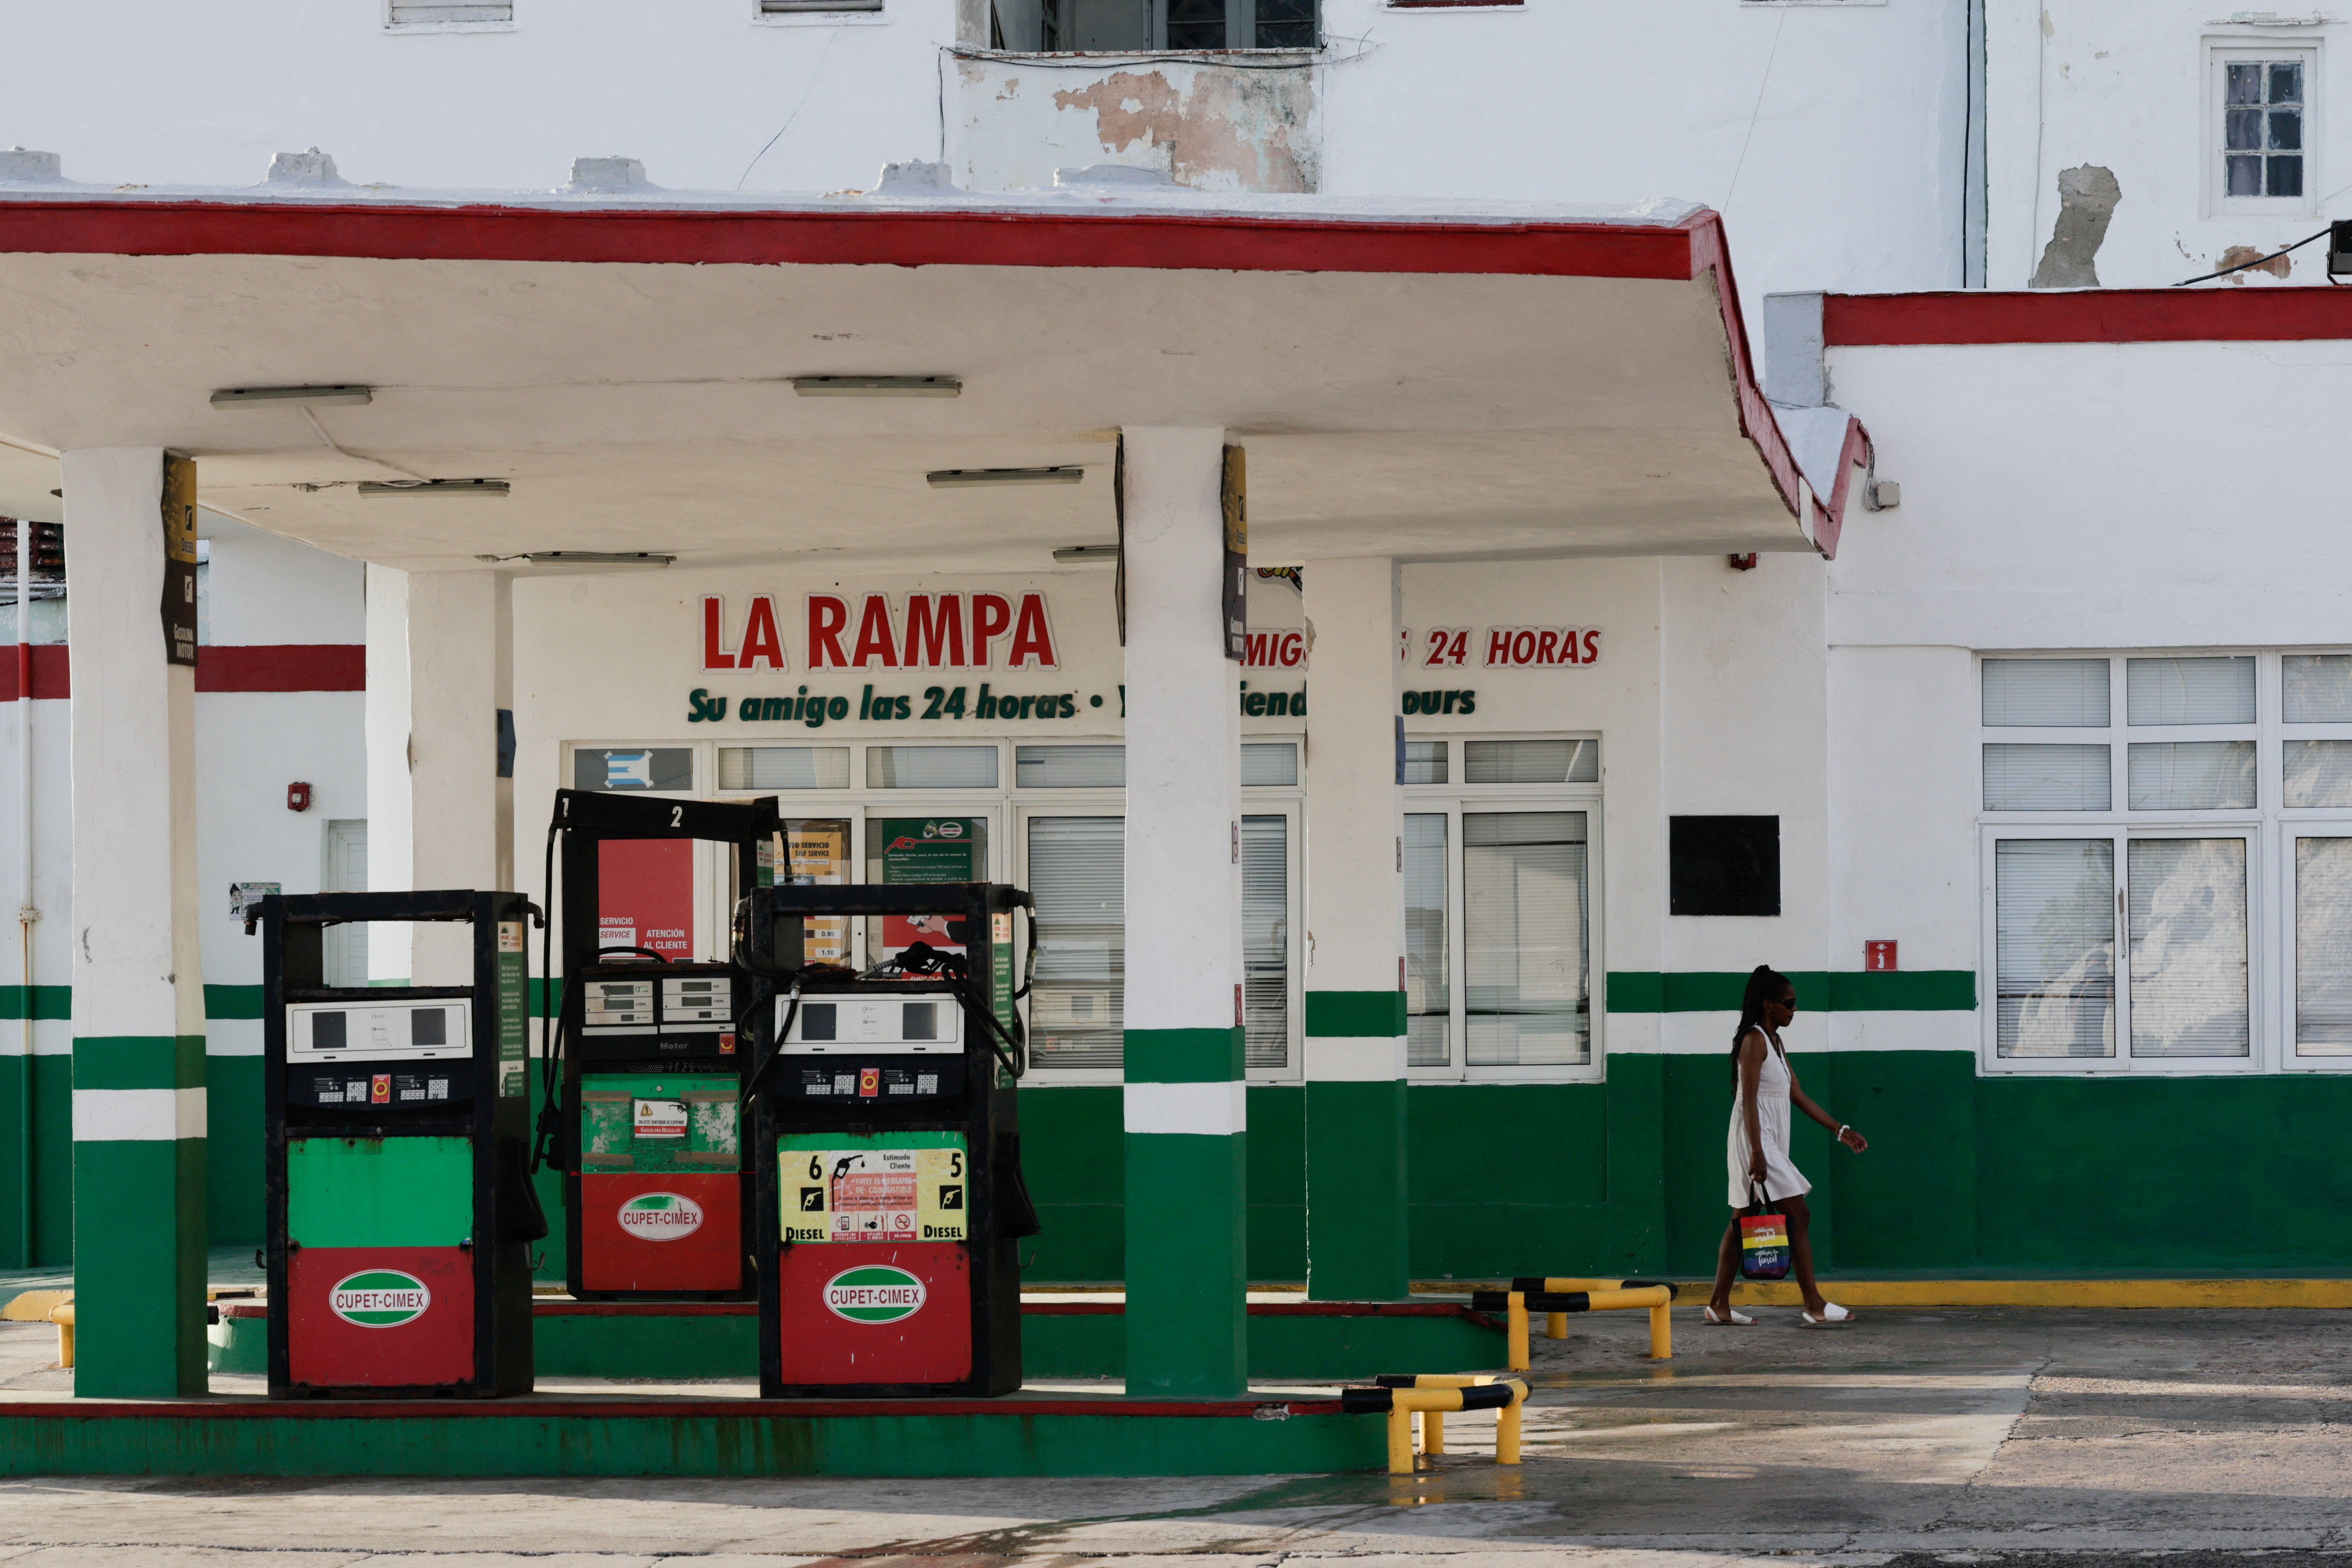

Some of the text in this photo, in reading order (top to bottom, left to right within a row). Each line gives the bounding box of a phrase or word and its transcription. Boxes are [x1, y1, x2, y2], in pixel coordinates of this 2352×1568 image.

[182, 537, 194, 554] DIESEL
[174, 623, 193, 642] GASOLINA
[705, 594, 1054, 669] LA RAMPA
[177, 642, 194, 659] MOTOR
[1240, 633, 1307, 666] MIG
[1429, 631, 1467, 664] 24
[1488, 630, 1600, 664] HORAS
[688, 681, 1476, 728] Su amigo las 24 horas iend ours
[562, 798, 682, 827] 1 2
[646, 928, 684, 937] ATENCIÓN
[809, 1155, 822, 1180] 6
[951, 1153, 961, 1178] 5
[624, 1212, 697, 1225] CUPET-CIMEX
[786, 1227, 824, 1241] DIESEL
[924, 1225, 962, 1238] DIESEL
[1756, 1231, 1776, 1243] pride!
[1759, 1254, 1777, 1266] fierté!
[337, 1293, 423, 1308] CUPET-CIMEX
[830, 1289, 919, 1305] CUPET-CIMEX
